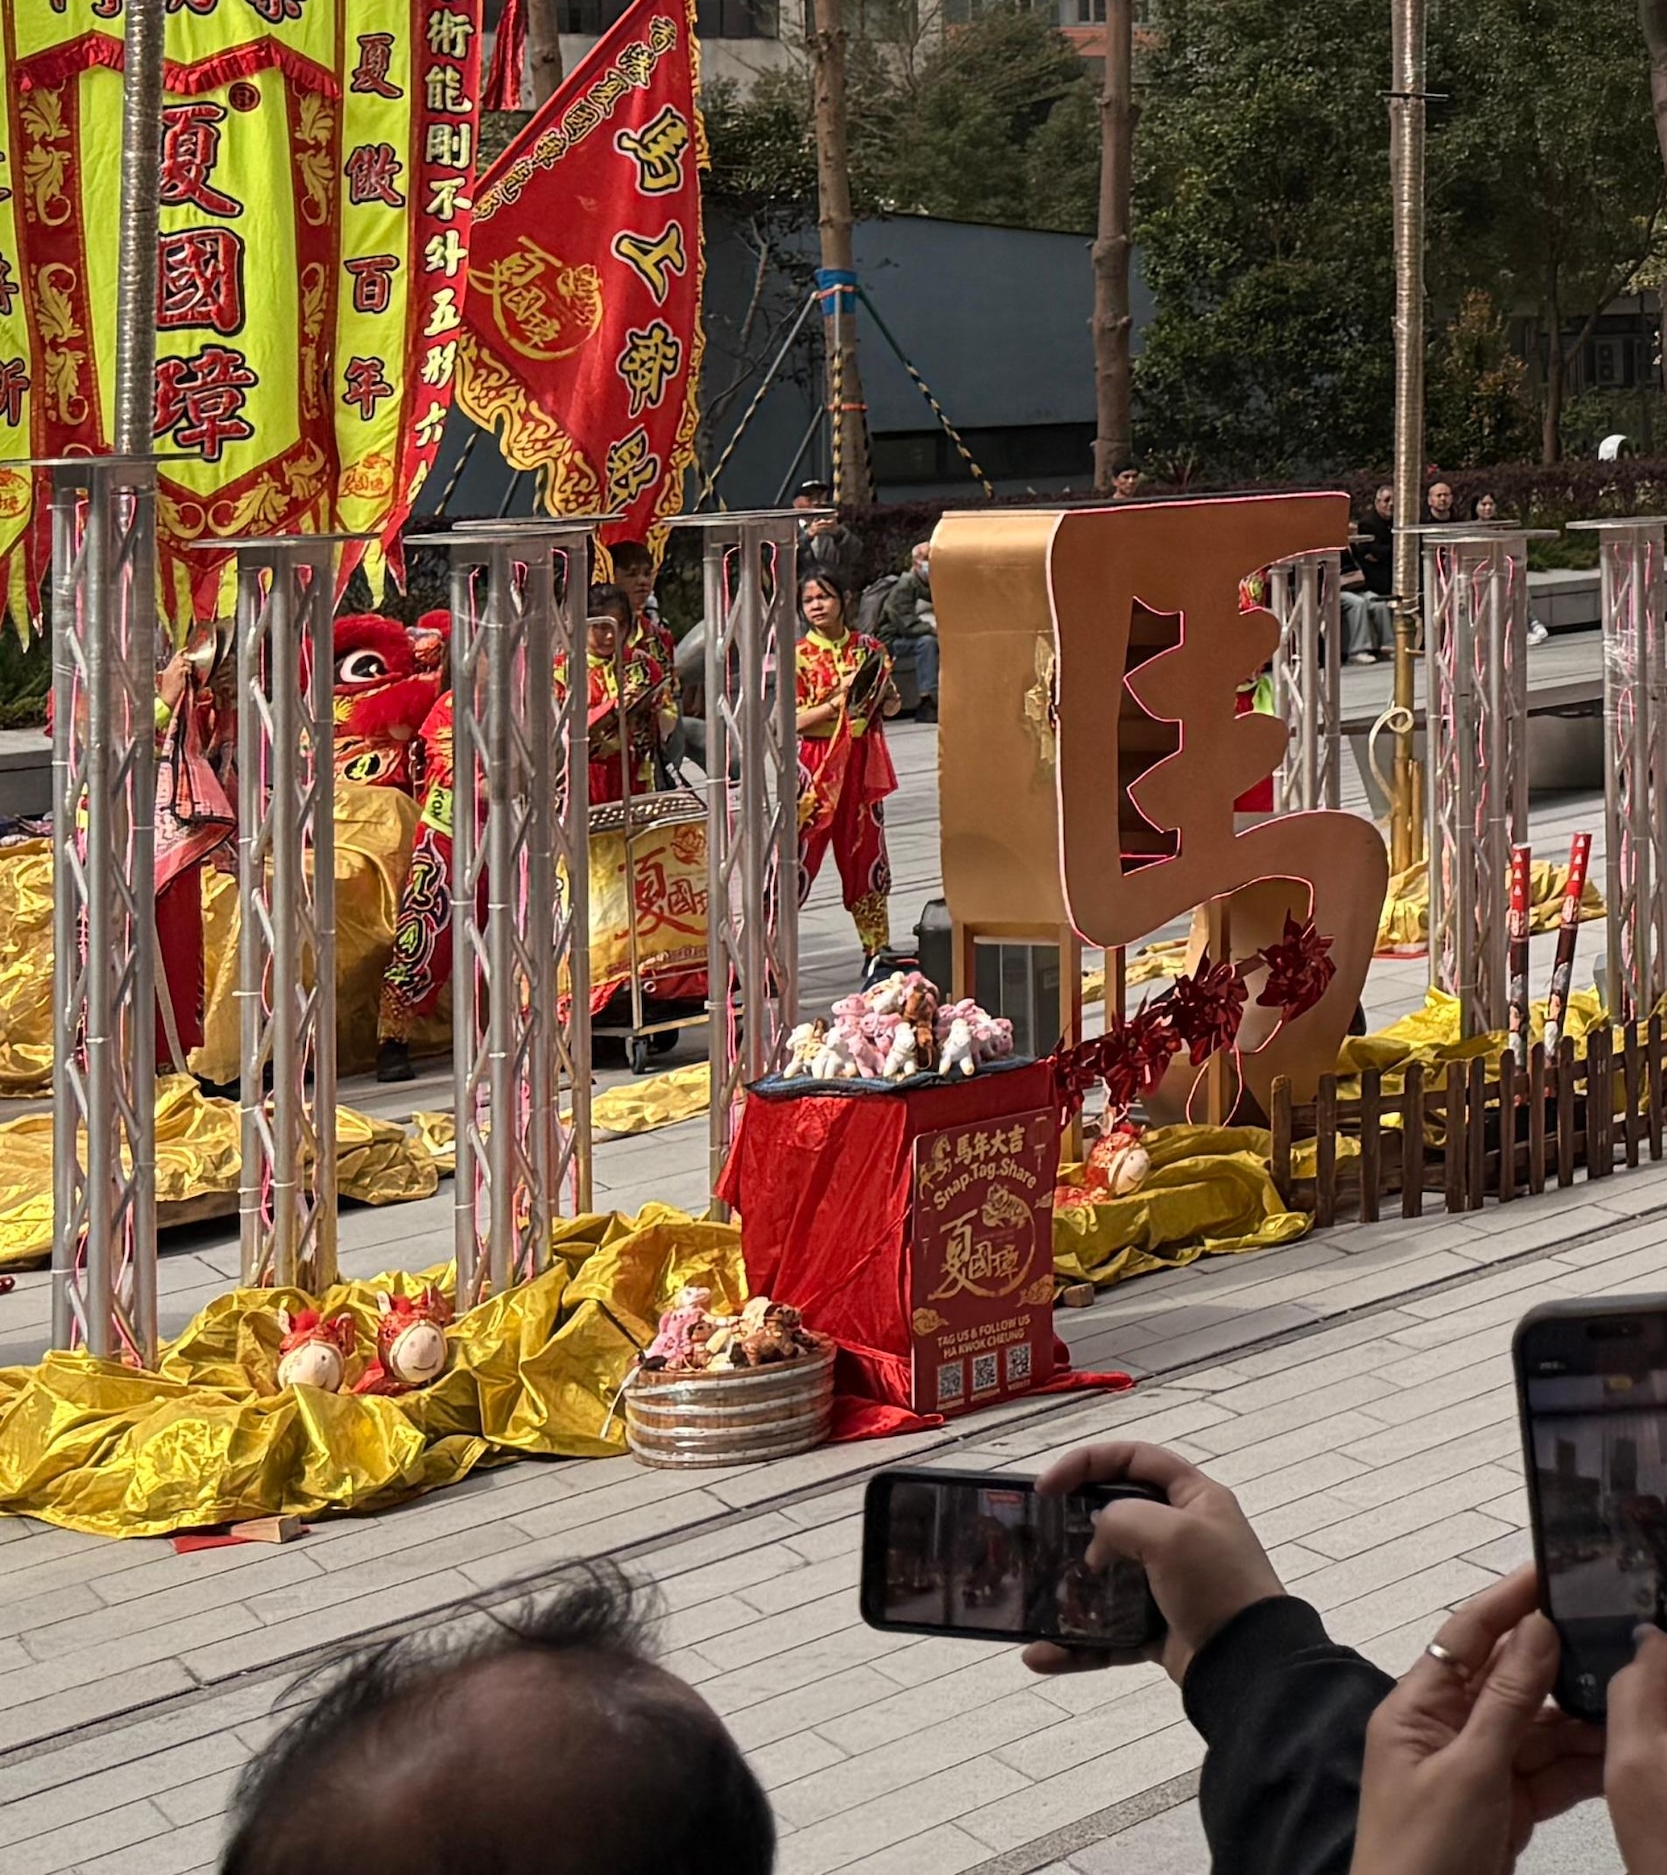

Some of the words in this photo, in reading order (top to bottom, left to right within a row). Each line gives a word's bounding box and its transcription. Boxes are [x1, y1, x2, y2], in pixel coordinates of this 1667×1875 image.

[954, 1124, 1025, 1165] 馬年大吉
[937, 1335, 955, 1348] TAG
[957, 1329, 970, 1343] US
[979, 1316, 1017, 1338] FOLLOW
[1017, 1314, 1031, 1326] US
